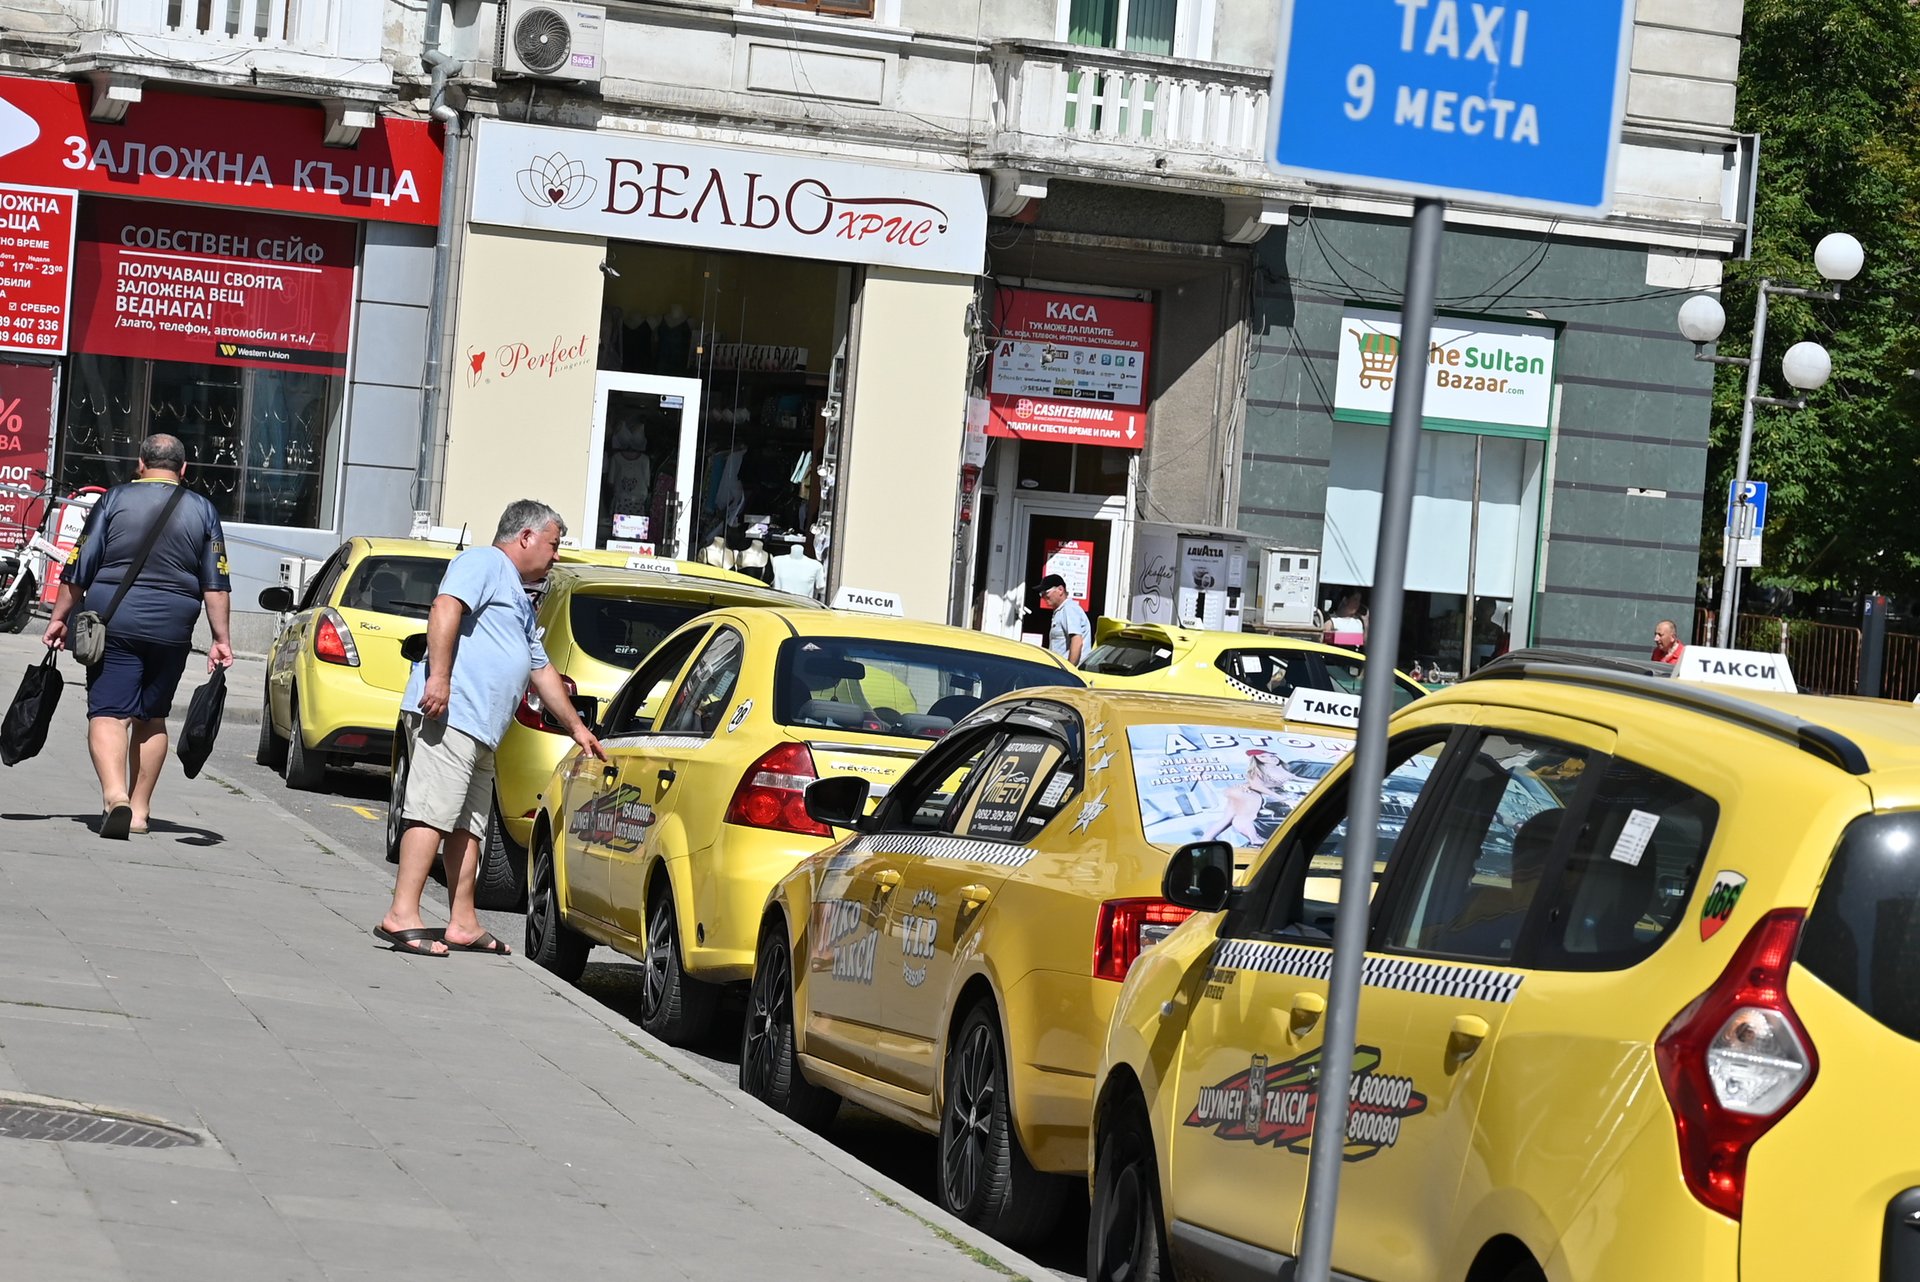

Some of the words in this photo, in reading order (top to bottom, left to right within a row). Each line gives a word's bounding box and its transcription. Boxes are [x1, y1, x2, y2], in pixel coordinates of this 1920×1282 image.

[1395, 0, 1528, 67] TAXI
[1344, 64, 1375, 120] 9
[1394, 86, 1540, 146] МЕСТА
[62, 136, 275, 189] ЗАЛОЖНА
[293, 160, 420, 206] КЪЩА
[0, 194, 60, 214] ОЖНА
[601, 157, 836, 235] БЕЛЬО
[17, 239, 50, 250] ВРЕМЕ
[120, 225, 249, 258] СОБСТВЕН
[256, 235, 324, 263] СЕЙФ
[118, 262, 220, 285] ПОЛУЧАВАШ
[223, 271, 284, 296] СВОЯТА
[117, 279, 205, 301] ЗАЛОЖЕНА
[208, 288, 244, 307] ВЕЩ
[21, 303, 60, 314] СРЕБРО
[116, 295, 213, 320] ВЕДНАГА!
[1046, 302, 1098, 322] КАСА
[13, 317, 34, 329] 407
[38, 319, 59, 331] 336
[115, 315, 156, 333] /злато,
[159, 320, 211, 337] телефон,
[214, 327, 277, 341] автомобил
[281, 333, 288, 341] и
[1029, 322, 1043, 331] ТУК
[1044, 323, 1067, 333] МОЖЕ
[1068, 325, 1078, 335] ДА
[1079, 326, 1115, 337] ПЛАТИТЕ:
[12, 332, 34, 344] 406
[37, 334, 58, 346] 697
[238, 347, 268, 358] Western
[268, 350, 290, 359] Union
[496, 335, 590, 378] Perfect
[1430, 342, 1460, 367] he
[1464, 347, 1545, 376] Sultan
[1033, 402, 1115, 421] CASHTERMINAL
[1006, 421, 1031, 432] ПЛАТИ
[1032, 423, 1039, 432] И
[1039, 424, 1067, 435] СПЕСТИ
[1068, 426, 1093, 437] ВРЕМЕ
[1094, 429, 1100, 437] И
[1100, 429, 1121, 439] ПАРИ
[65, 524, 82, 533] Mon
[1187, 545, 1223, 558] LAVAZZA
[633, 562, 671, 572] ТАКСИ
[848, 594, 894, 608] ТАКСИ
[360, 622, 381, 630] Rio
[1699, 659, 1776, 680] ТАКСИ
[731, 706, 748, 725] 28
[1159, 766, 1186, 775] НА
[1190, 763, 1230, 773] КОЛИ
[832, 930, 878, 982] ТАКСИ
[1359, 1079, 1411, 1109] 800000
[1197, 1088, 1244, 1121] ШУМЕН
[1265, 1091, 1309, 1124] ТАКСИ
[1348, 1111, 1399, 1144] 800080
